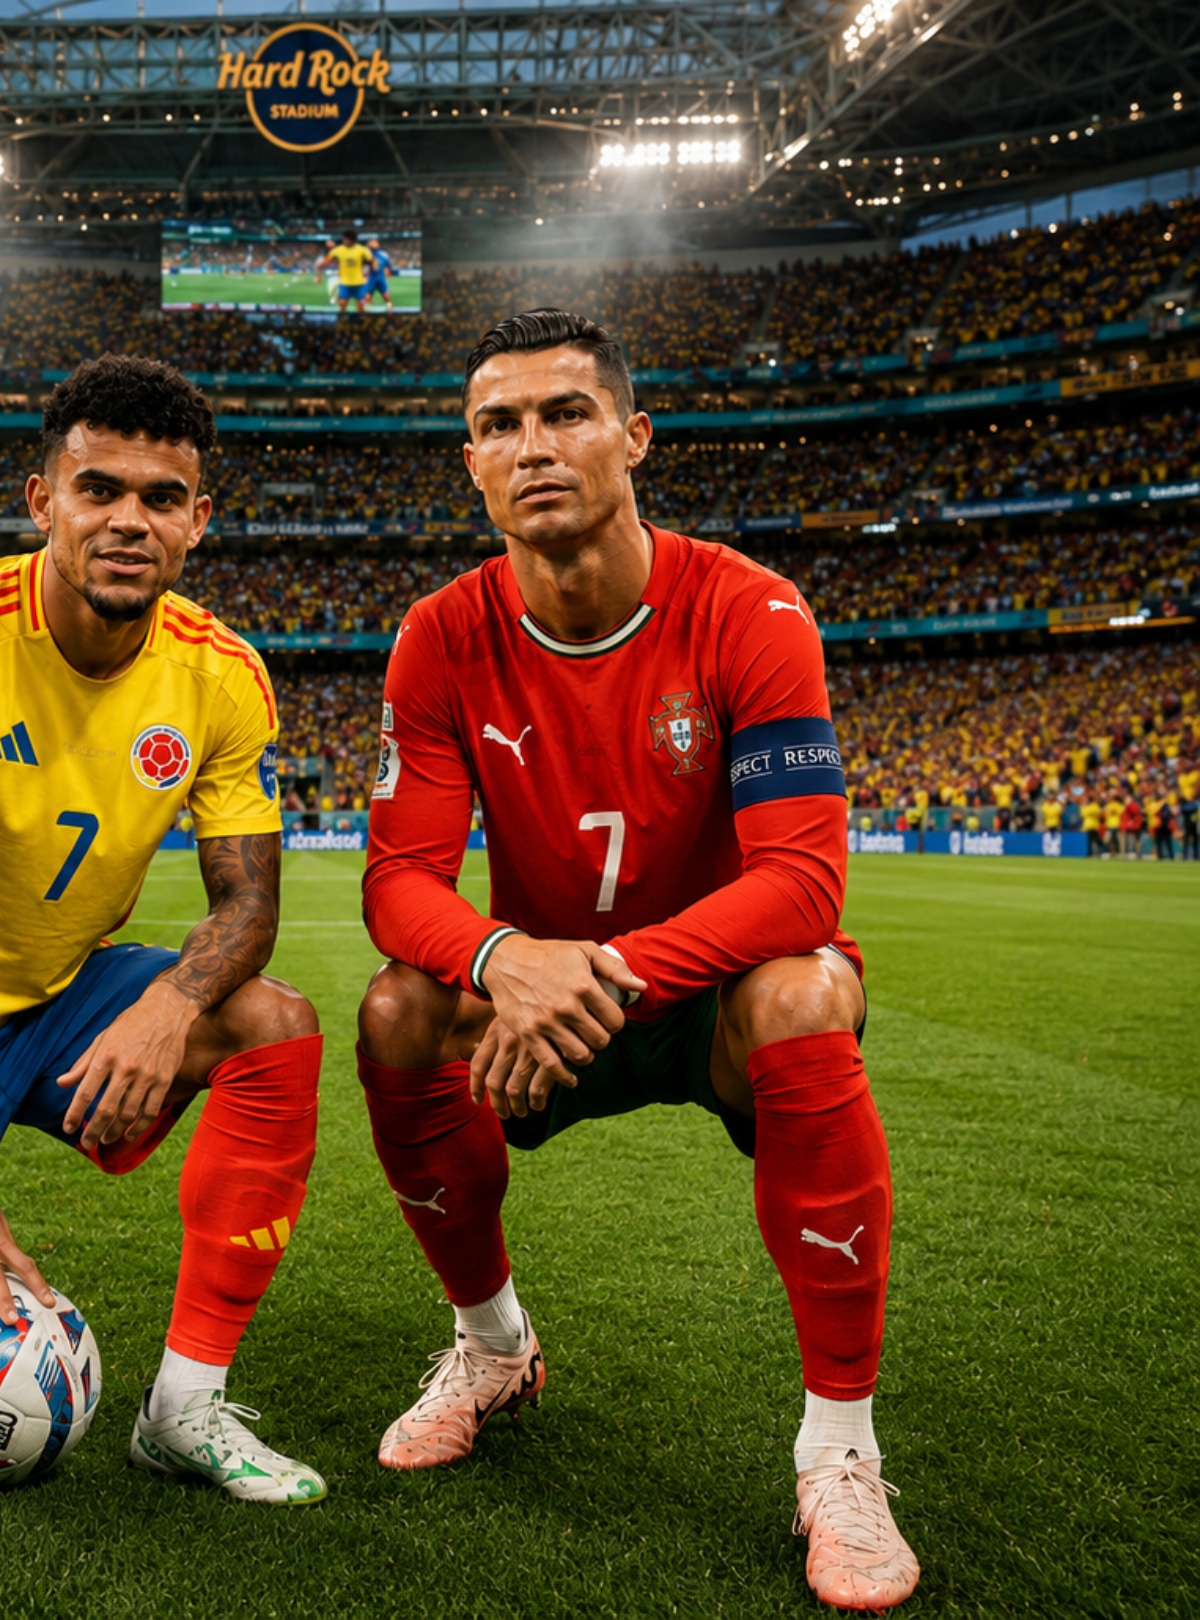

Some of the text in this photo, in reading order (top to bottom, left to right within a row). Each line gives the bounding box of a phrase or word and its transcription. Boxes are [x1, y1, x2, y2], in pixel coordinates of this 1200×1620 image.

[217, 50, 390, 96] Hard Rock
[270, 103, 340, 119] STADIUM
[44, 811, 99, 901] 7
[579, 811, 625, 912] 7
